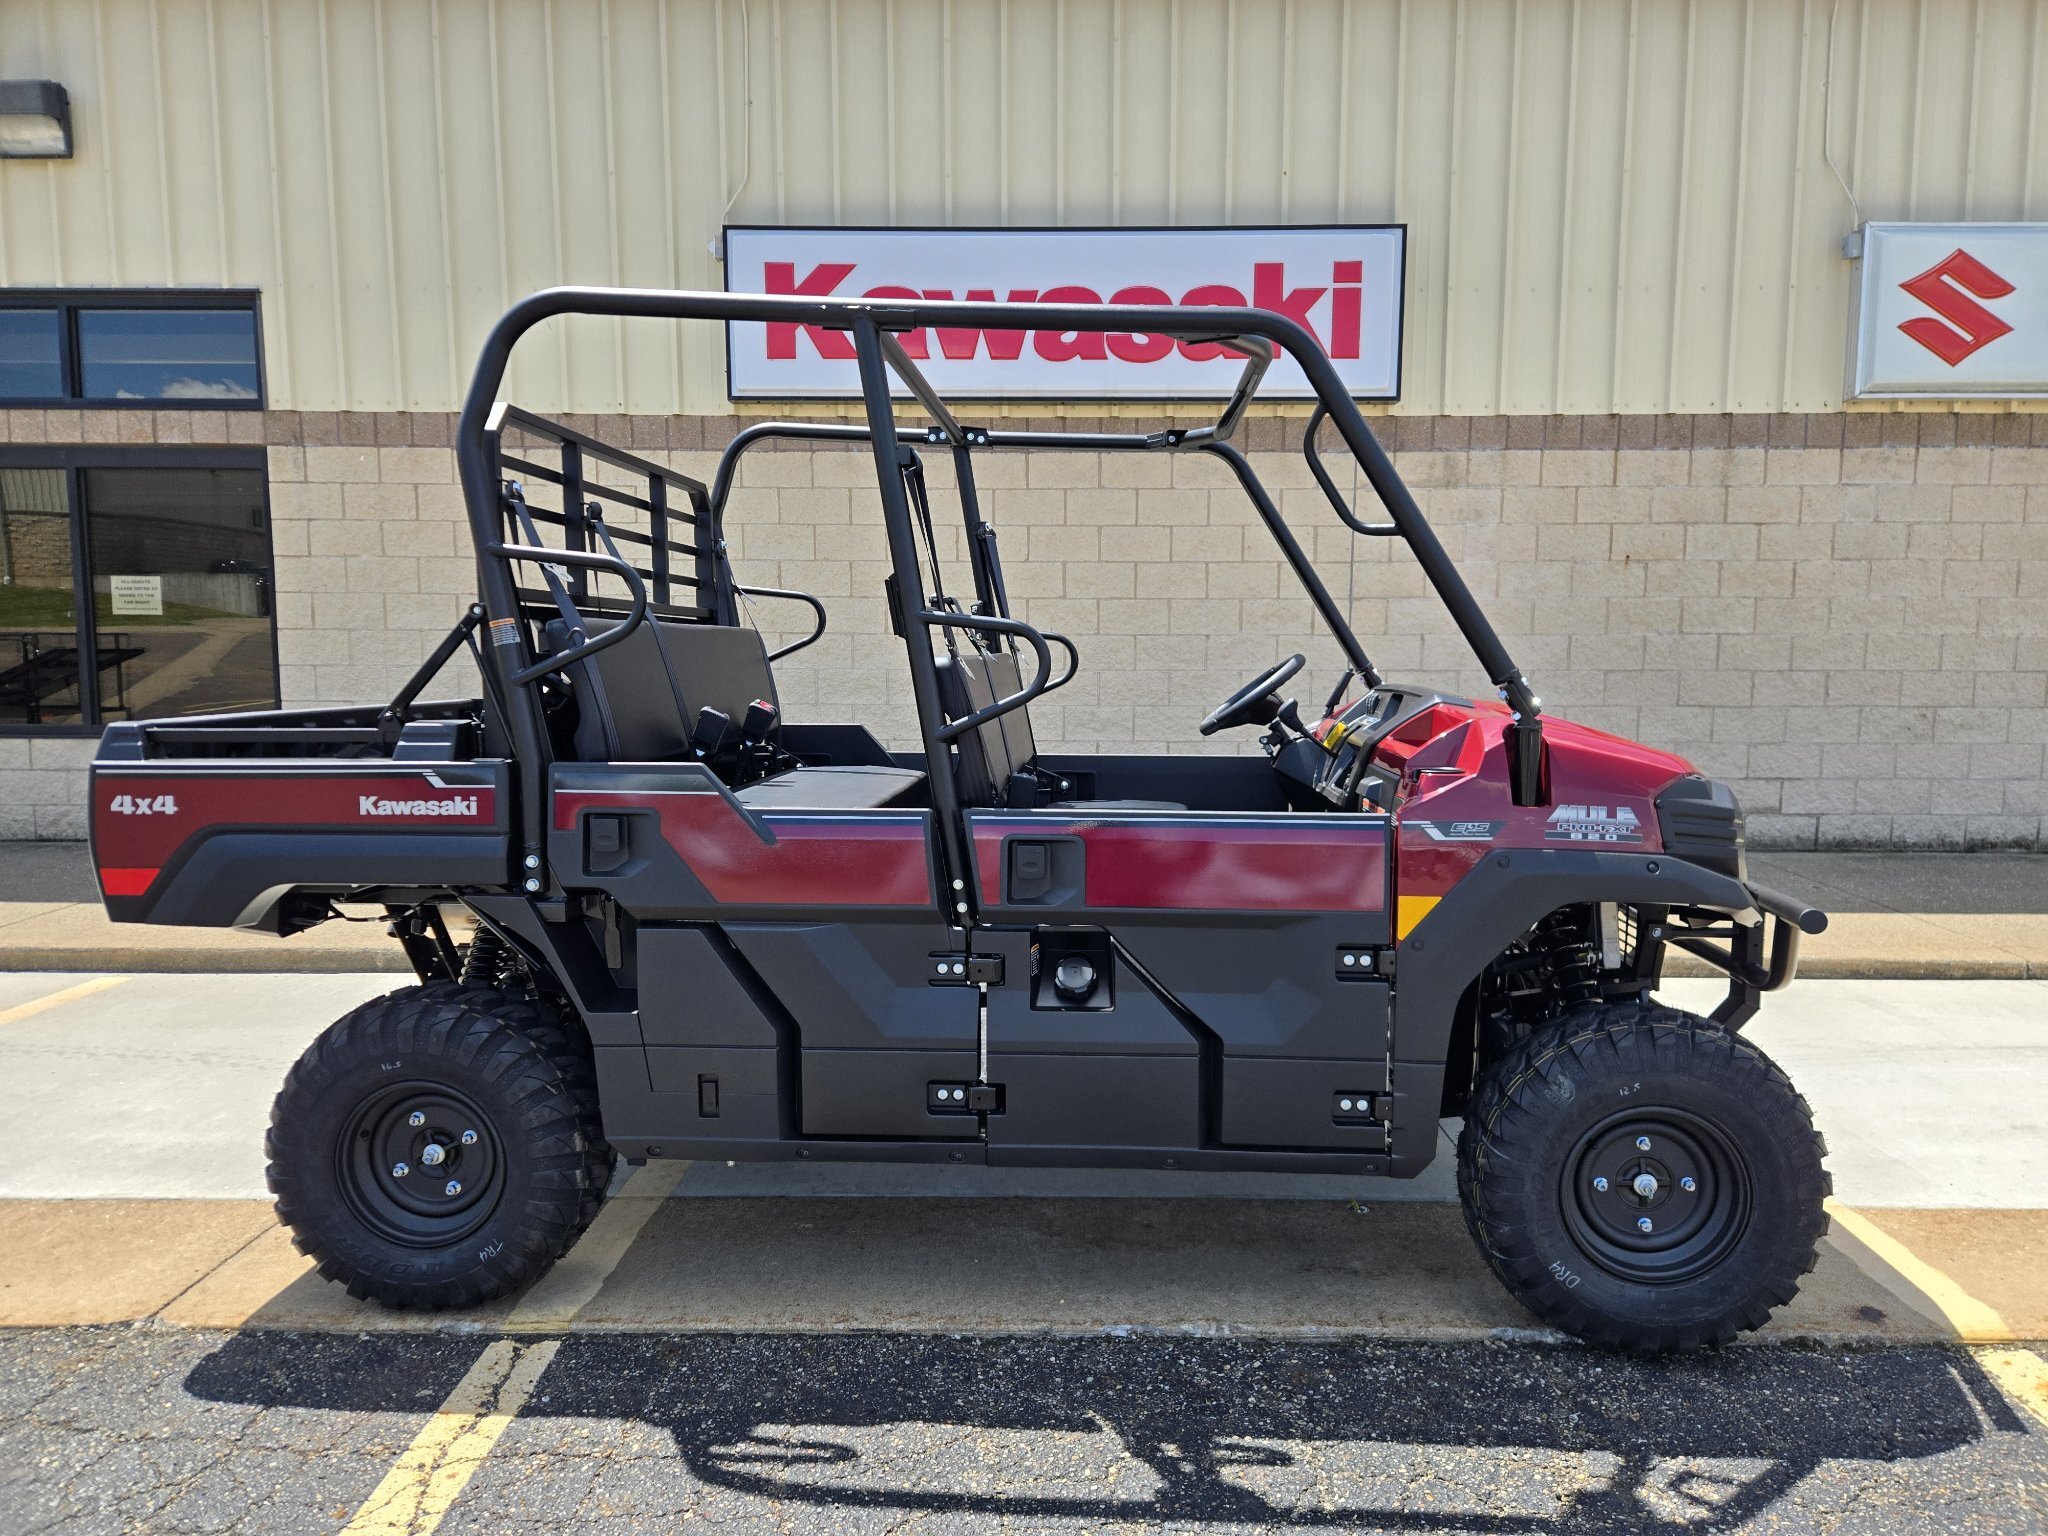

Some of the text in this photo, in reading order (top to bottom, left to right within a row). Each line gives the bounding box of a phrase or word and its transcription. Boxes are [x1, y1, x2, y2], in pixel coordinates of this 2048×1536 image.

[110, 795, 179, 815] 4x4
[359, 796, 478, 816] Kawasaki
[1546, 804, 1641, 826] MULE
